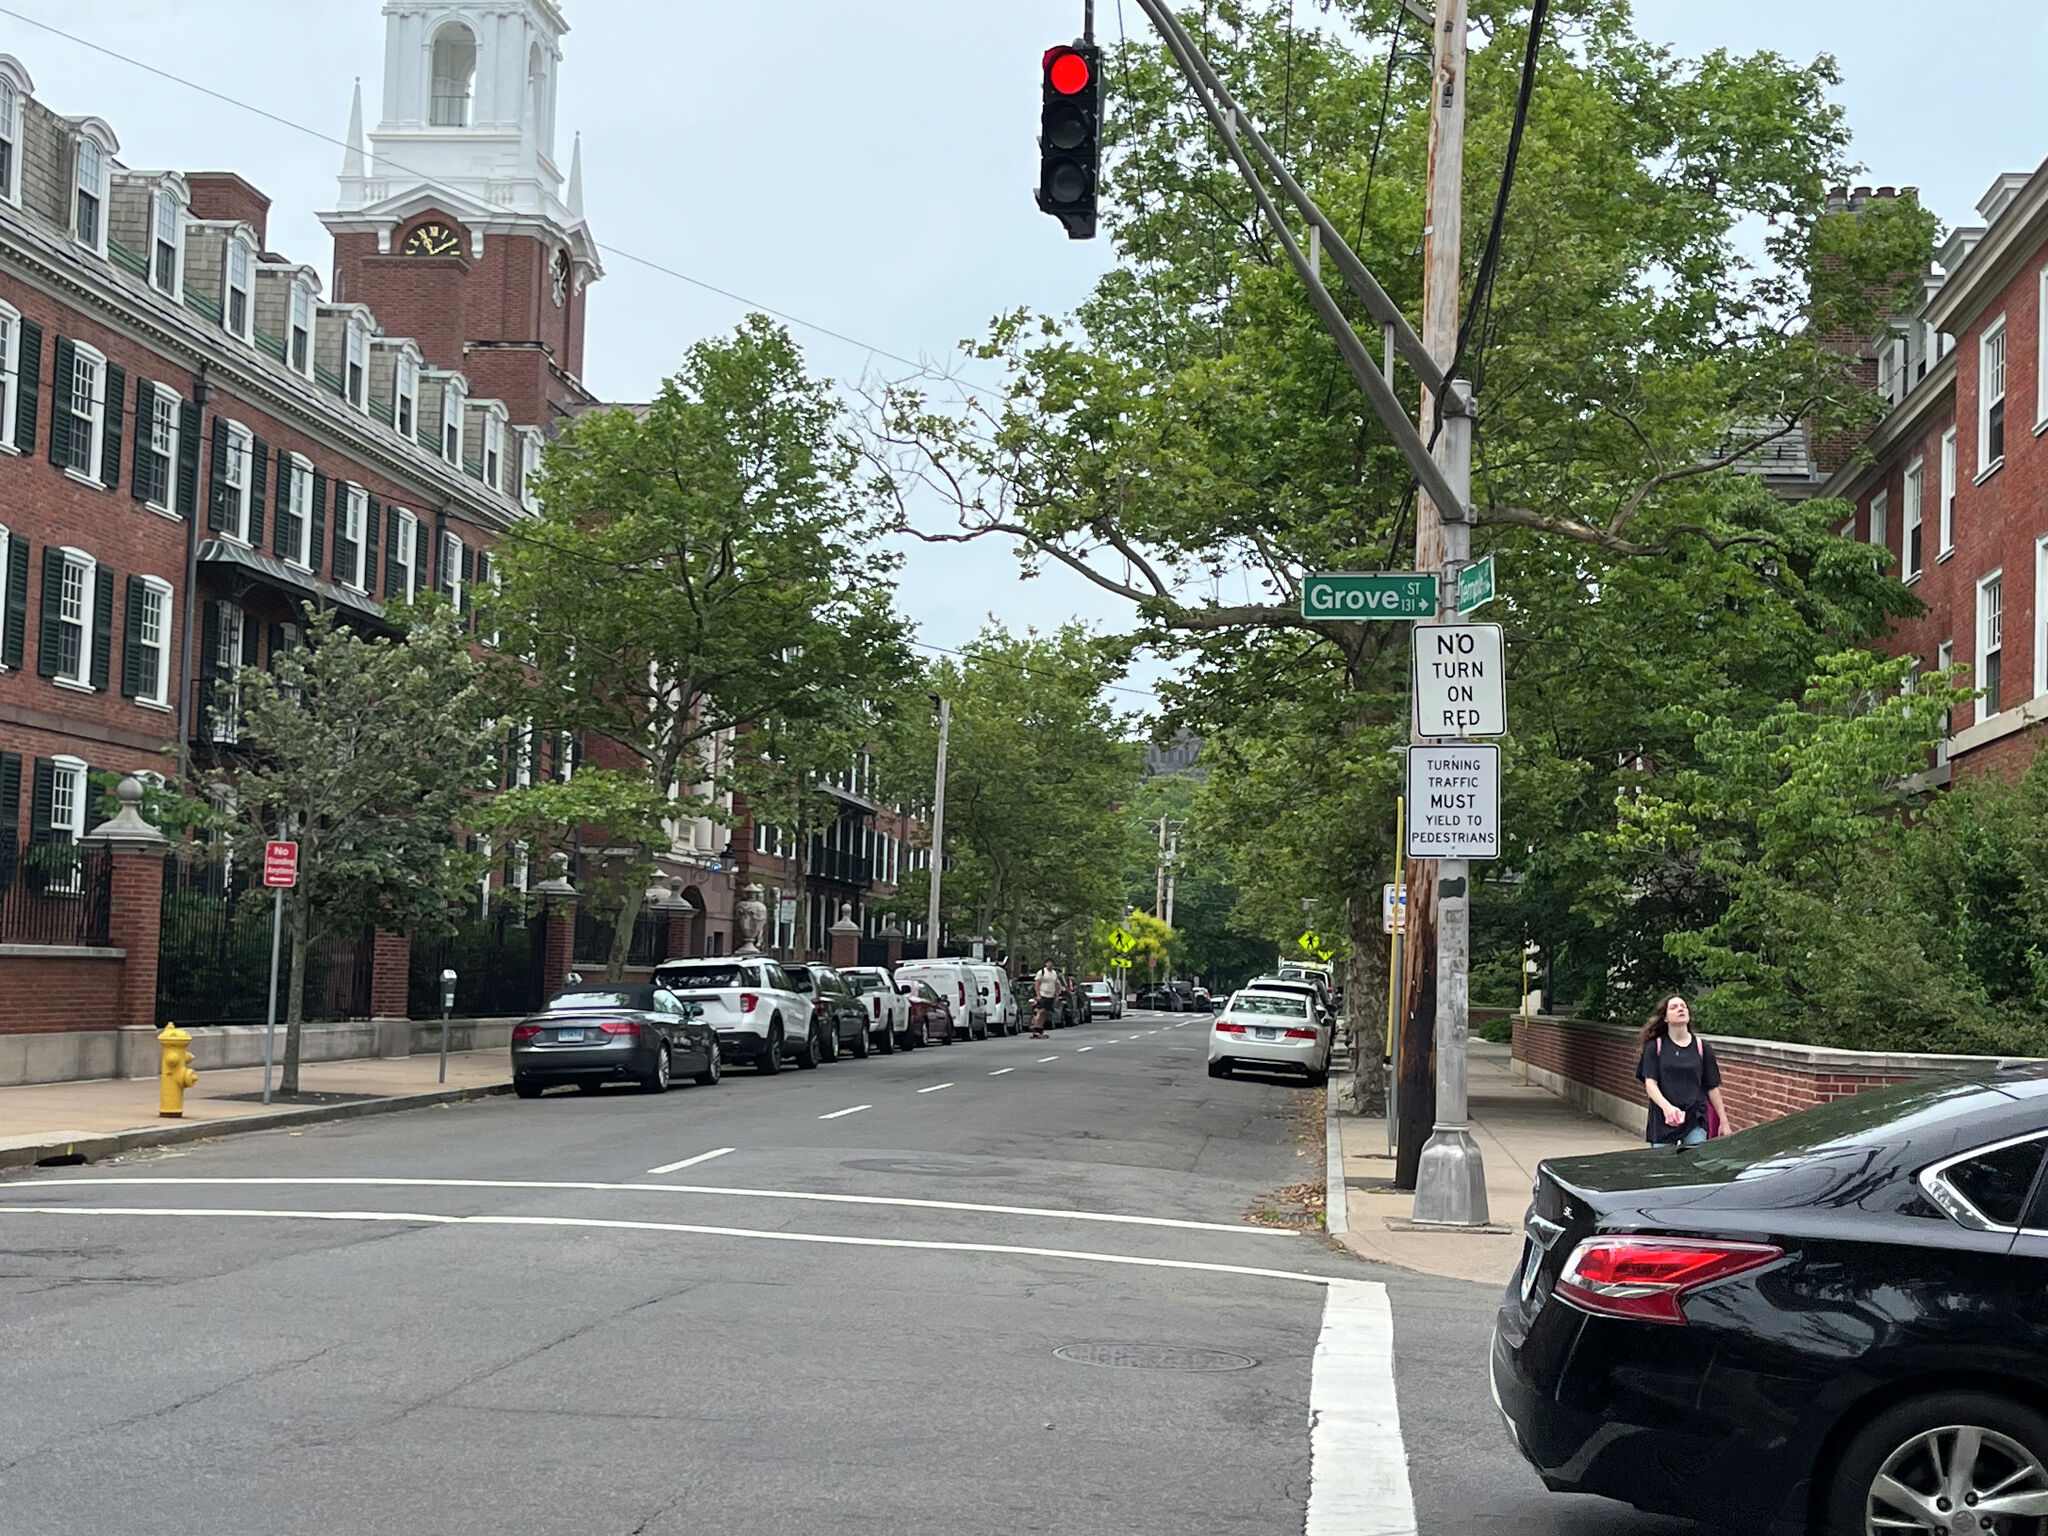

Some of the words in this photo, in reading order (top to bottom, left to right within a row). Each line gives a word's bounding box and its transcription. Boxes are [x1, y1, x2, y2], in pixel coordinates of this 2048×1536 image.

[1311, 584, 1400, 610] Grove
[1407, 582, 1421, 595] ST
[1437, 634, 1474, 654] NO
[1432, 661, 1483, 679] TURN
[1447, 686, 1473, 702] ON
[1443, 709, 1480, 726] RED
[1427, 760, 1480, 771] TURNING
[1428, 777, 1479, 788] TRAFFIC
[1431, 794, 1476, 809] MUST
[1425, 815, 1461, 826] YIELD
[1467, 815, 1482, 826] TO
[1412, 832, 1495, 843] PEDESTRIANS
[274, 846, 289, 856] No
